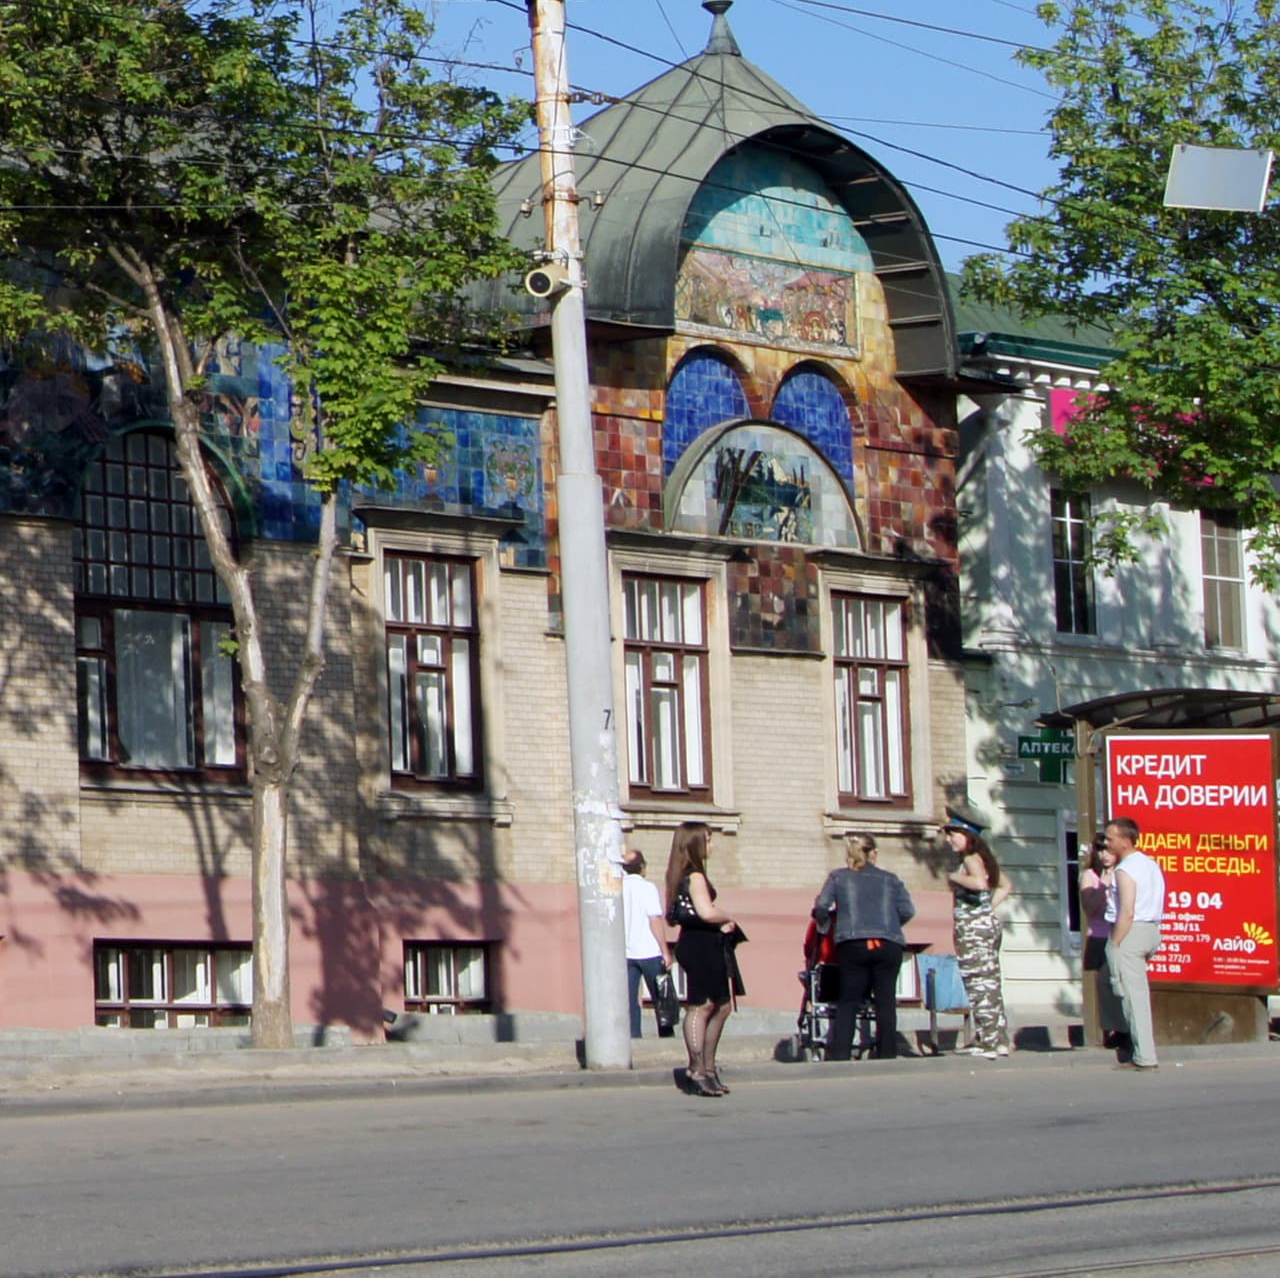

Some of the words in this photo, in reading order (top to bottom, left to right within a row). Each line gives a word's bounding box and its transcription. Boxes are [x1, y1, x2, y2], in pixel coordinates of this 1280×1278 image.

[1116, 754, 1207, 779] КРЕДИТ
[1117, 784, 1149, 805] НА
[1154, 784, 1268, 810] ДОВЕРИИ
[1196, 834, 1268, 853] ДЕНЬГИ
[1183, 856, 1261, 877] БЕСЕДЫ.
[1168, 891, 1192, 908] 19
[1196, 891, 1223, 909] 04
